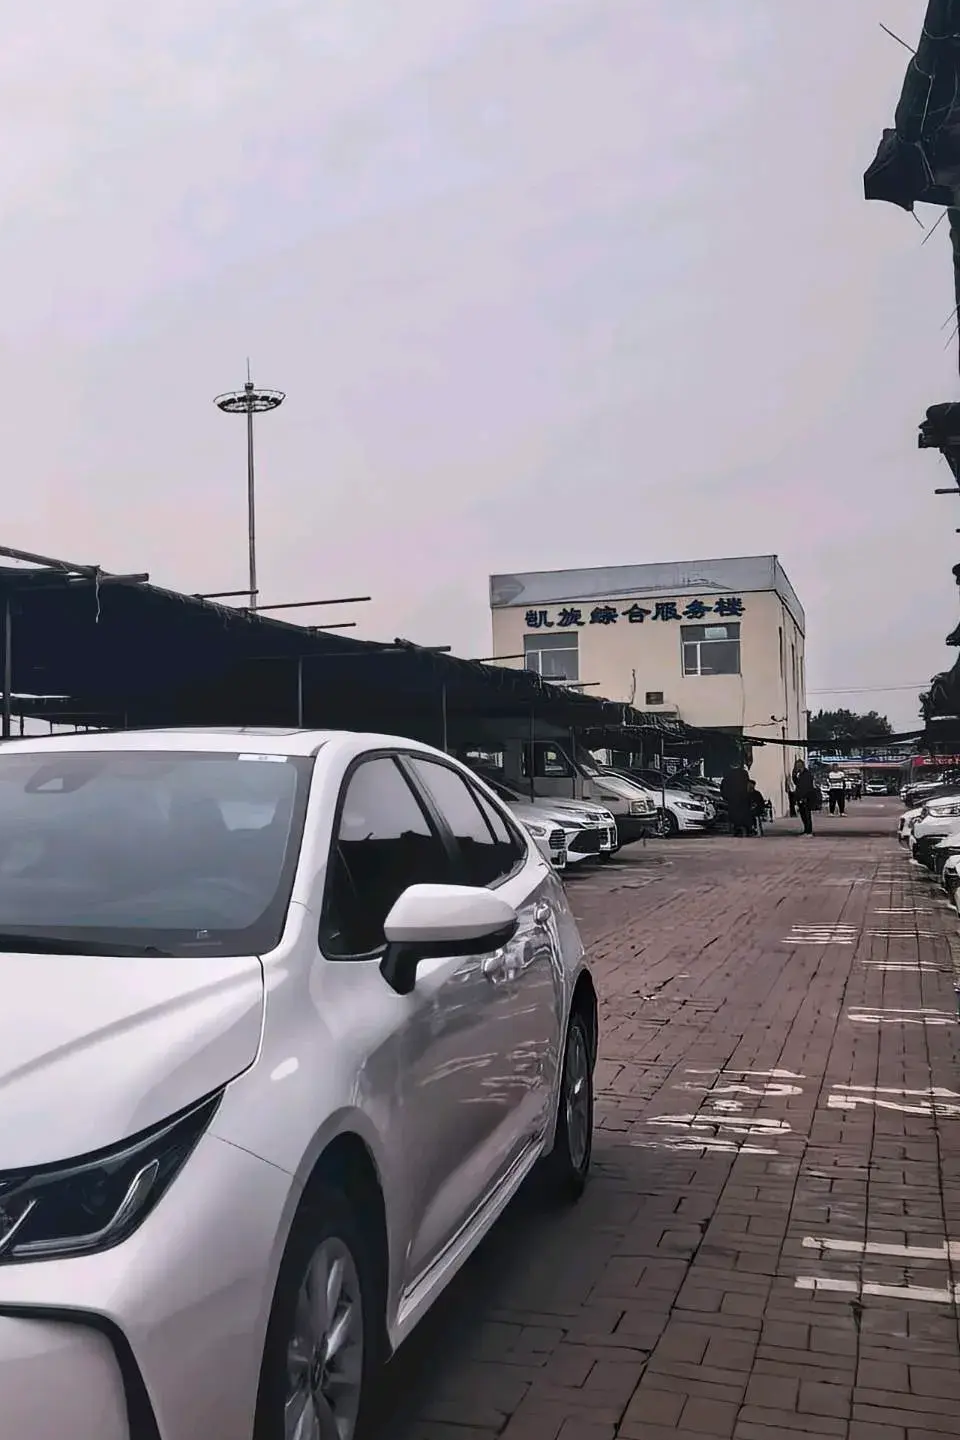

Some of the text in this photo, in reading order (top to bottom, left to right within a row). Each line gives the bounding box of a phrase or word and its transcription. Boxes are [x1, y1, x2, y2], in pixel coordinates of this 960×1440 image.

[525, 597, 746, 628] 凯旋综合服务楼
